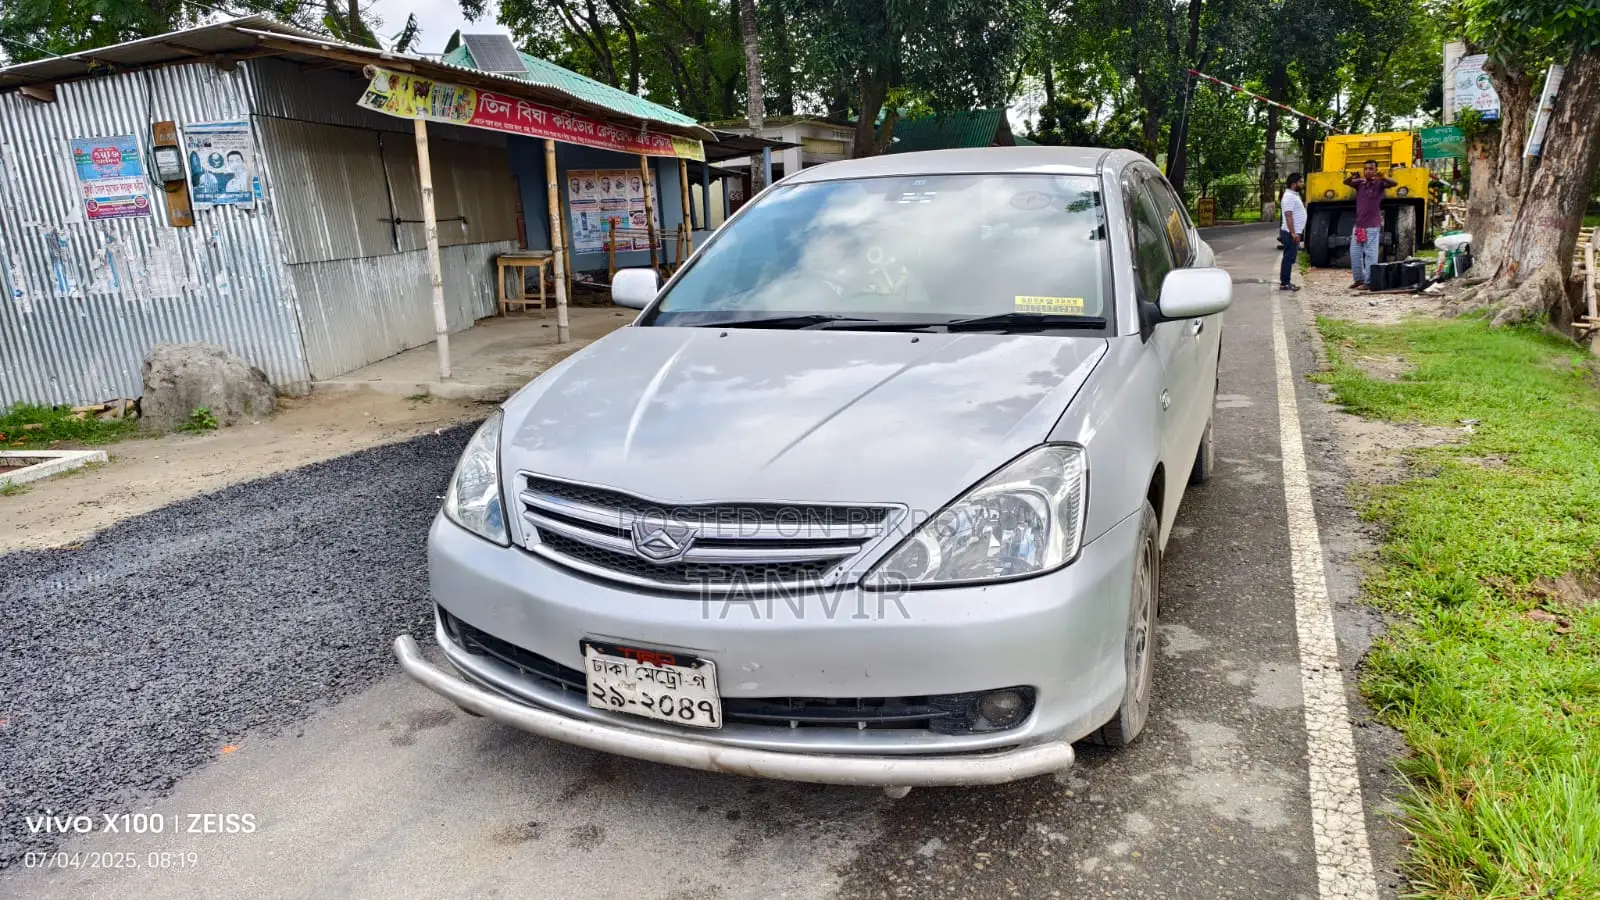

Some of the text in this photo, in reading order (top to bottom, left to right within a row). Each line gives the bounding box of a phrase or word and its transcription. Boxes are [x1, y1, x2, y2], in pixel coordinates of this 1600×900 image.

[479, 93, 512, 118] তিন
[516, 101, 547, 125] বিঘা
[592, 659, 629, 677] ঢাকা
[592, 682, 716, 723] ২৯-২০৪৭
